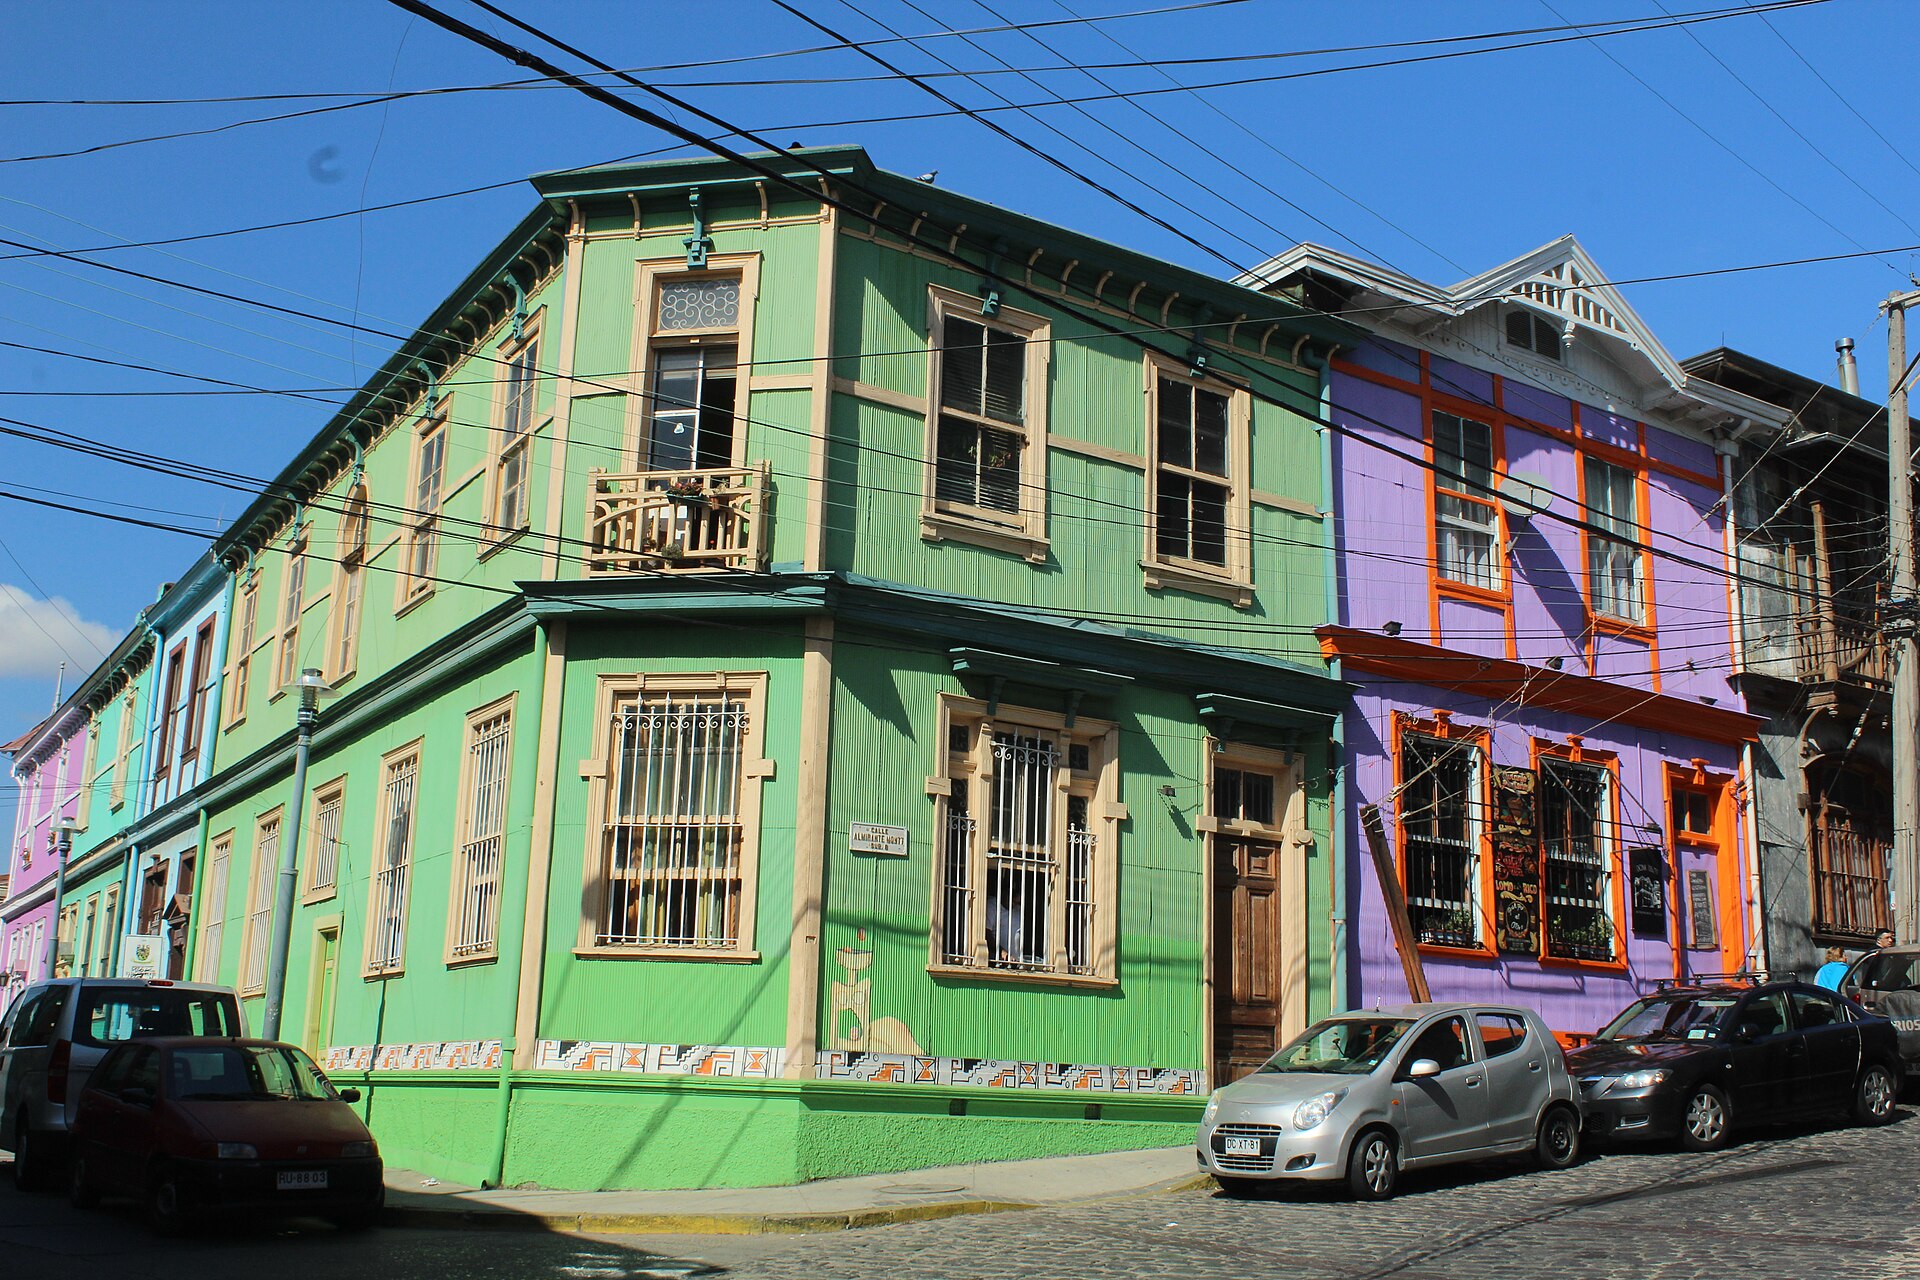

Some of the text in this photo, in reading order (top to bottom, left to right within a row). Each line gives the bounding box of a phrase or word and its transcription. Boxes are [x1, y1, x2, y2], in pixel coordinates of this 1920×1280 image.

[870, 827, 889, 835] CALLE
[853, 832, 904, 845] ALMIRANTE MONTT
[1495, 880, 1514, 892] LOMO
[1522, 882, 1538, 894] RICO
